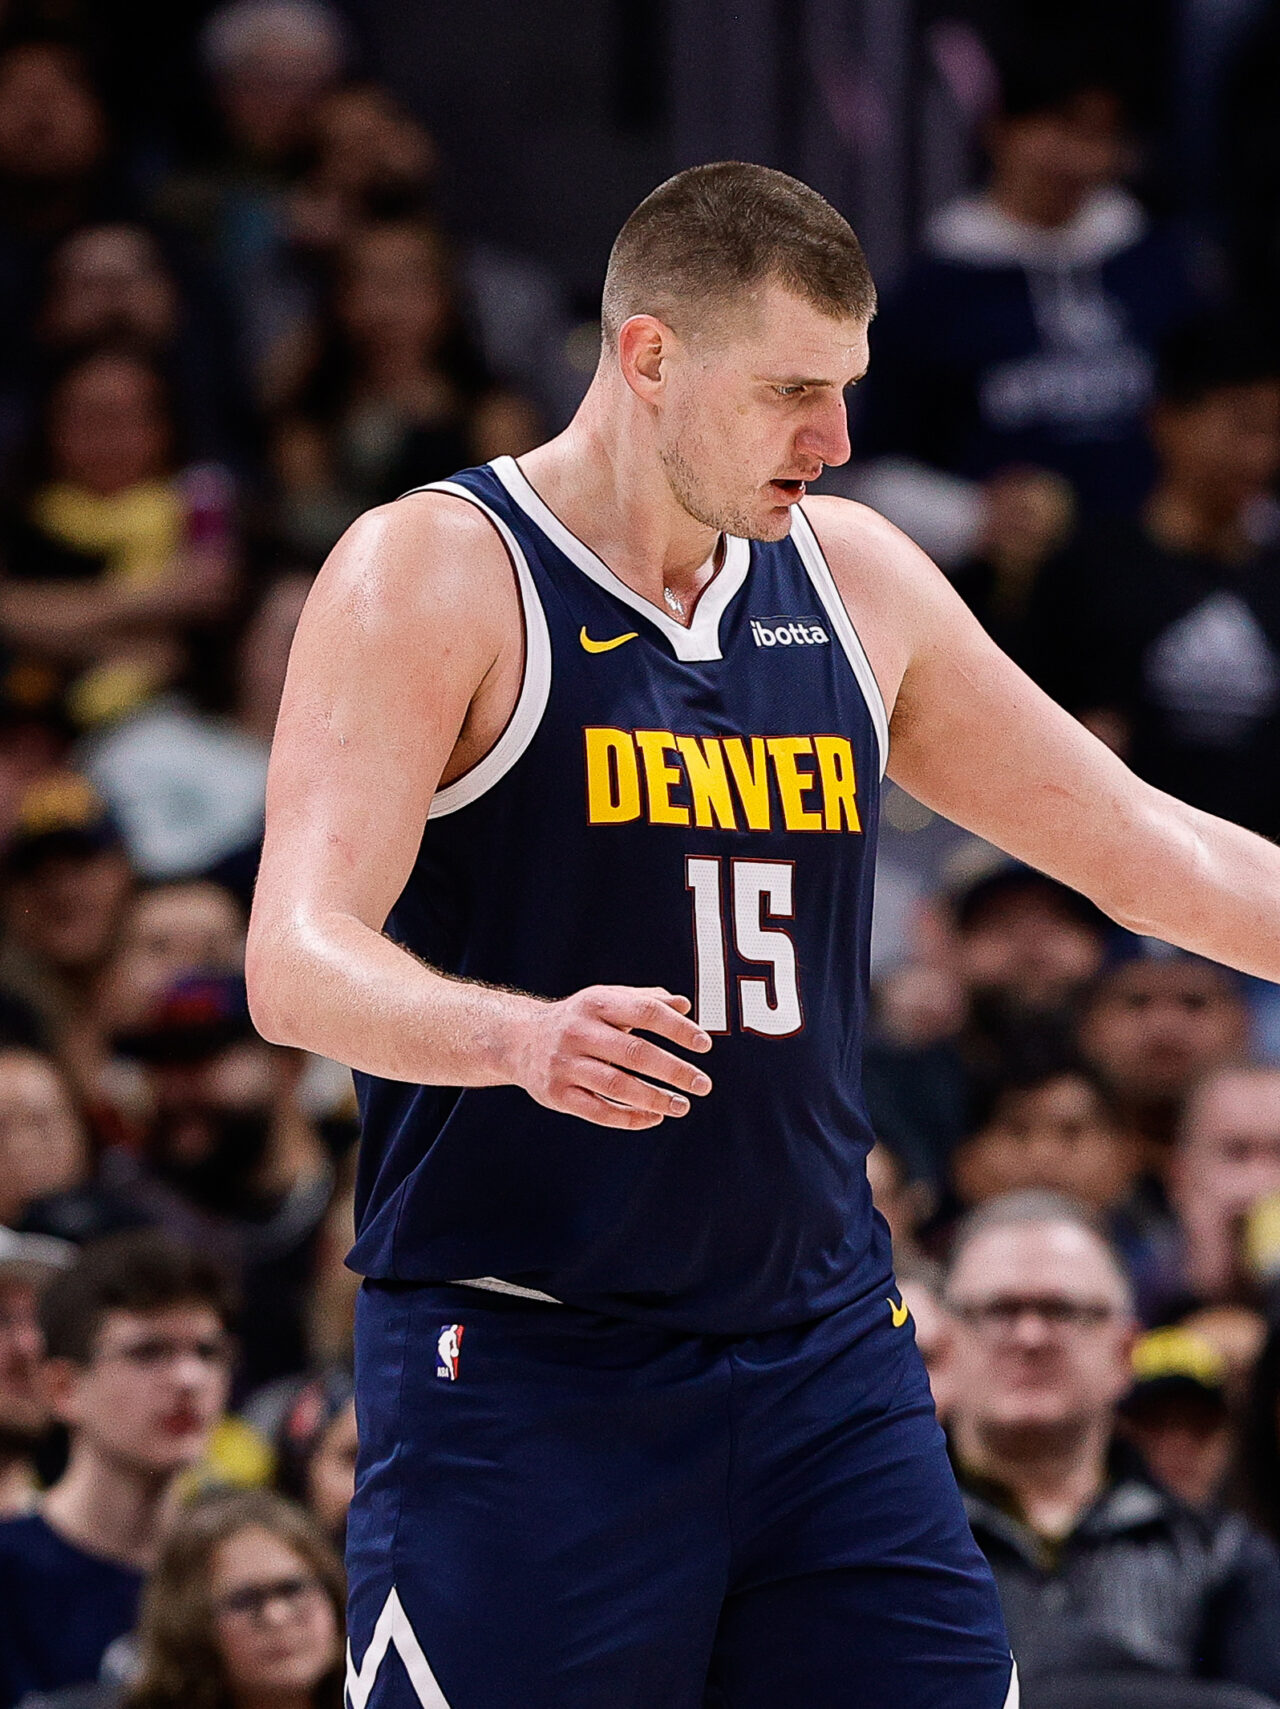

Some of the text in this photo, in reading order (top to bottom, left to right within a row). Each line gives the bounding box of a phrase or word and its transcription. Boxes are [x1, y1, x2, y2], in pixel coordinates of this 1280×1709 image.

[749, 620, 830, 647] ibotta
[582, 725, 863, 834] DENVER
[685, 854, 805, 1040] 15
